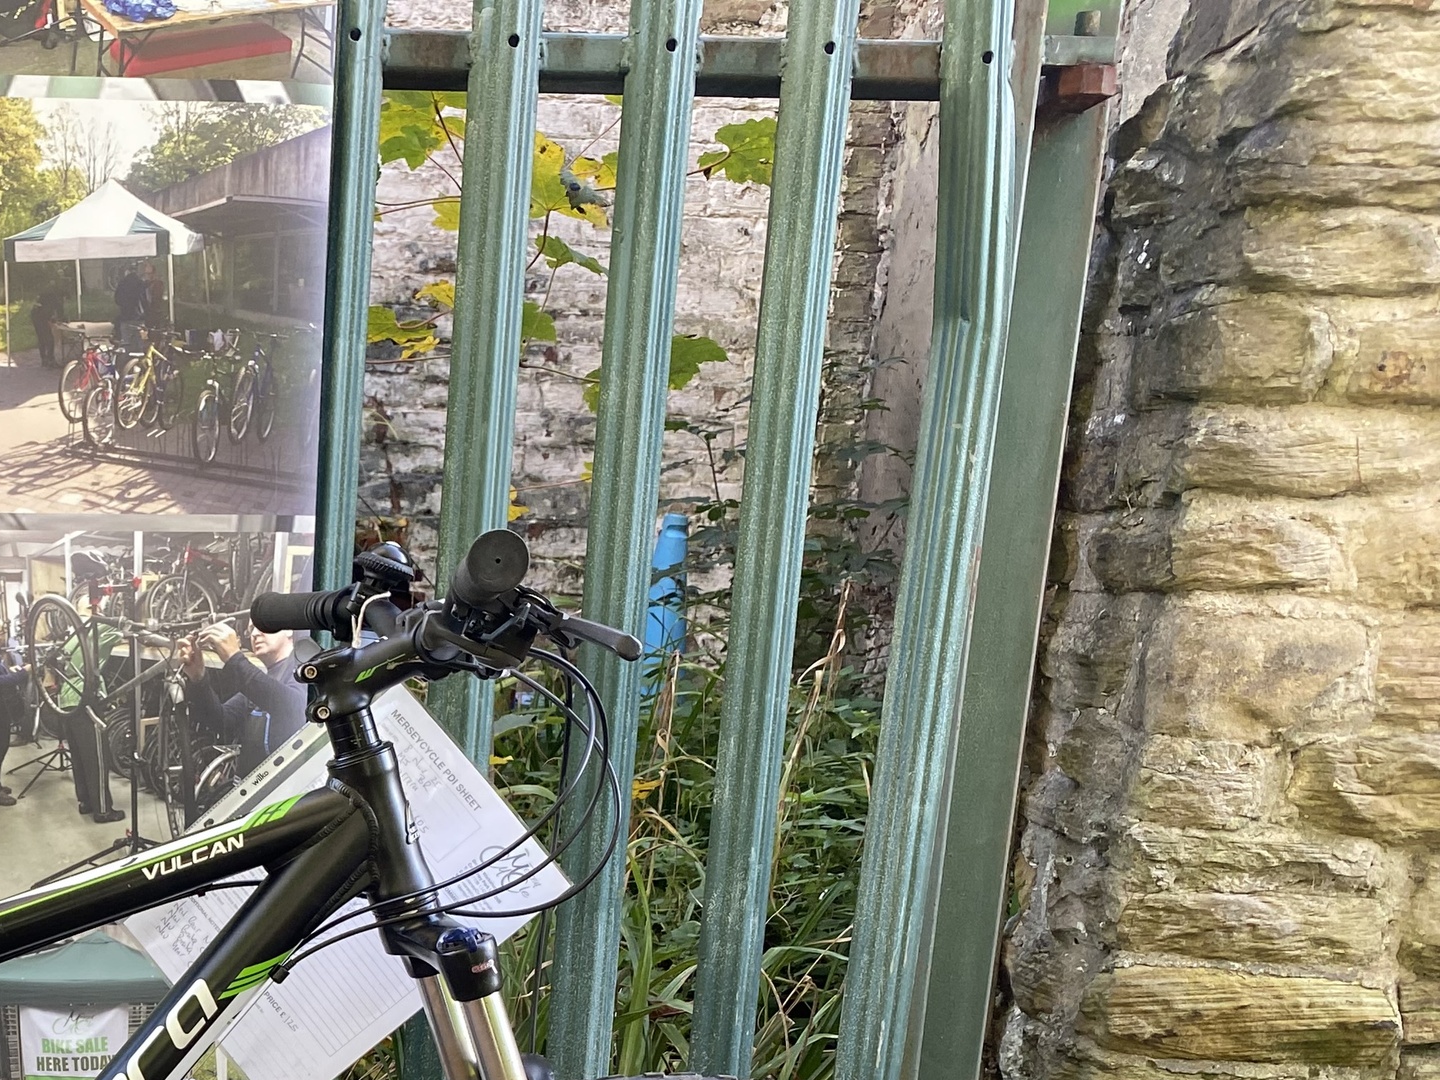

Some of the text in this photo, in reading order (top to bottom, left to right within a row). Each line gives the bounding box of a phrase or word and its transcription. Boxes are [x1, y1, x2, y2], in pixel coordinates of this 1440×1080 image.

[391, 709, 446, 771] MERSEYCYCLE
[443, 767, 461, 789] PDI
[456, 783, 481, 811] SHEET
[252, 771, 269, 786] wilko
[141, 833, 244, 880] VULCAN
[264, 991, 282, 1014] PRICE
[41, 1037, 108, 1055] BIKE SALE
[36, 1056, 69, 1072] HERE
